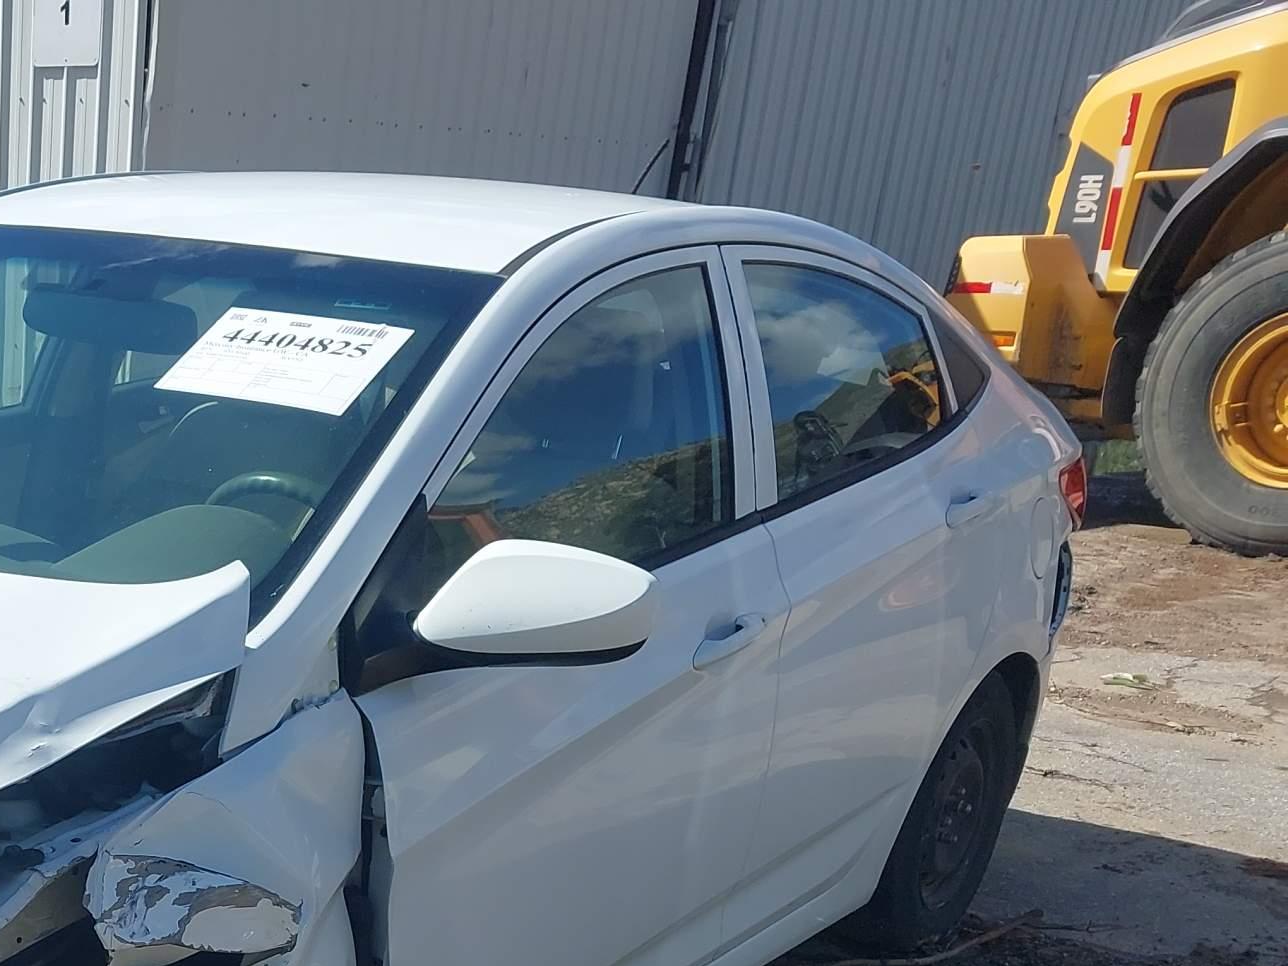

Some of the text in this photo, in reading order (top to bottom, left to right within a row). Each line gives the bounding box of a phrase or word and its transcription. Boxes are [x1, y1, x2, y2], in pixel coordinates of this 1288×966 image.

[60, 0, 70, 26] 1
[1072, 174, 1105, 223] L90H
[223, 328, 374, 359] 44404825
